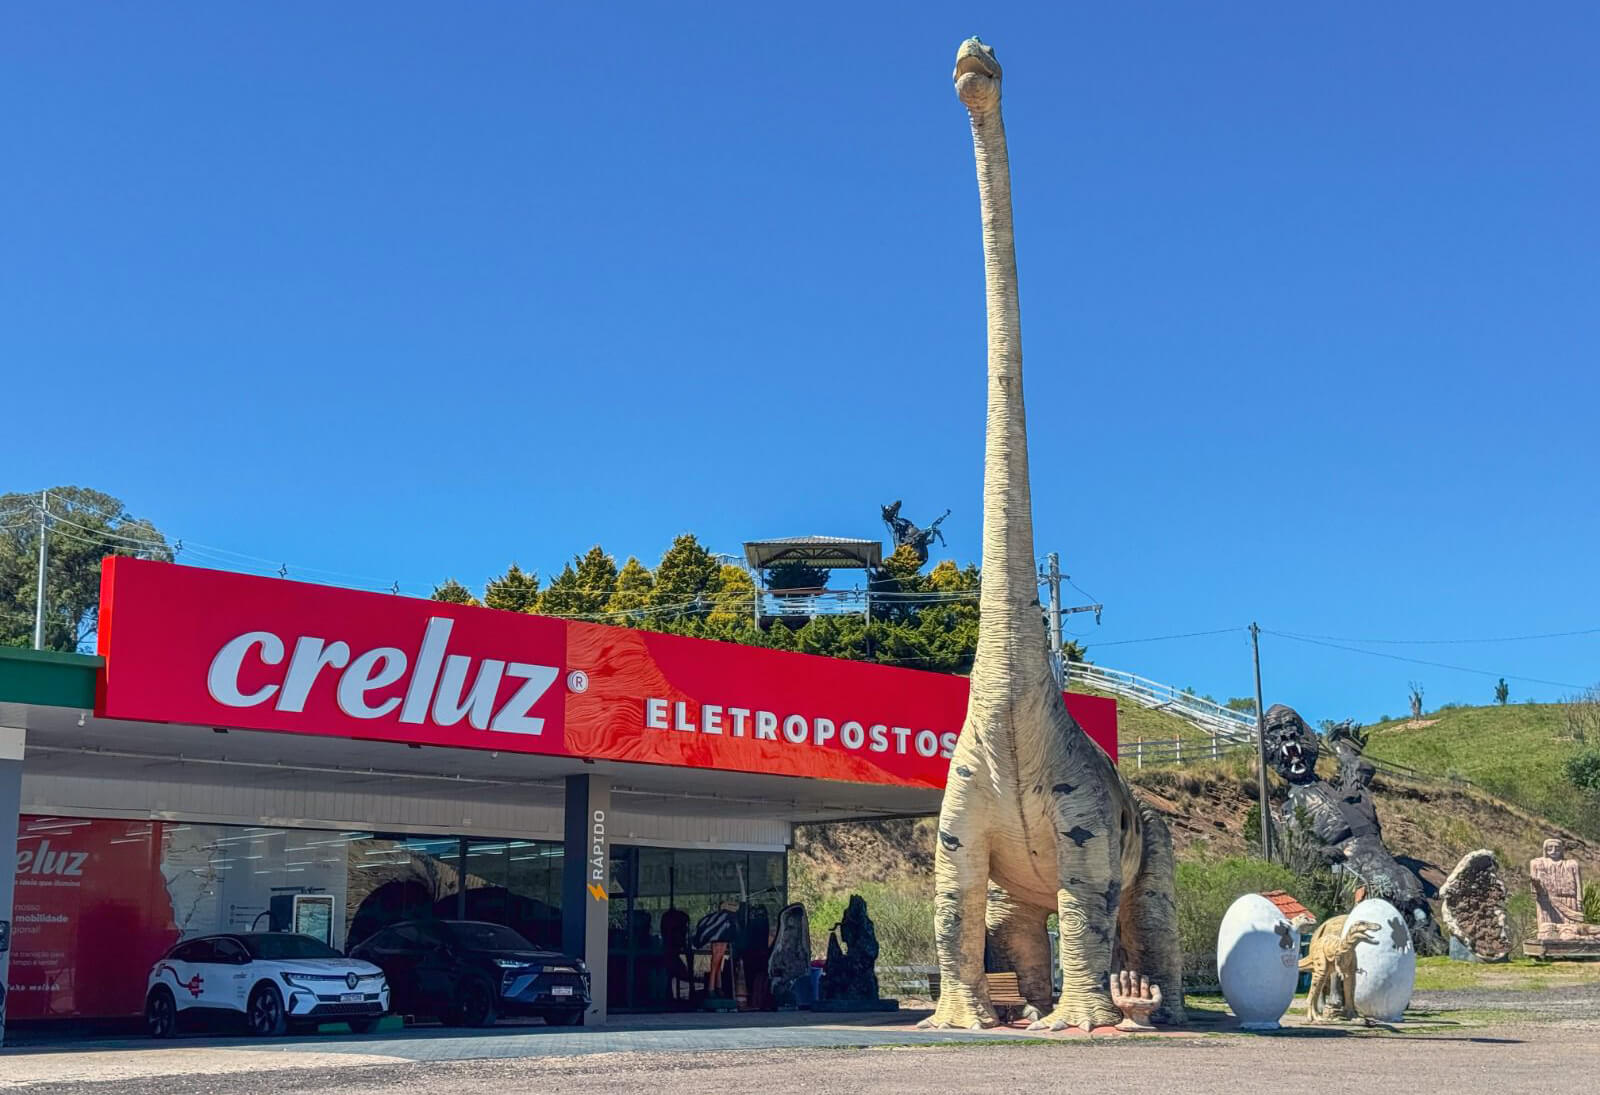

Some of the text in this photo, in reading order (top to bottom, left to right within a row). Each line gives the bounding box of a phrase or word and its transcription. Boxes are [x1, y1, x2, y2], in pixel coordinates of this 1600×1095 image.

[207, 616, 560, 735] creluz
[646, 697, 958, 758] ELETROPOSTOS
[589, 809, 605, 880] RÁPIDO
[15, 913, 68, 923] mobilidade
